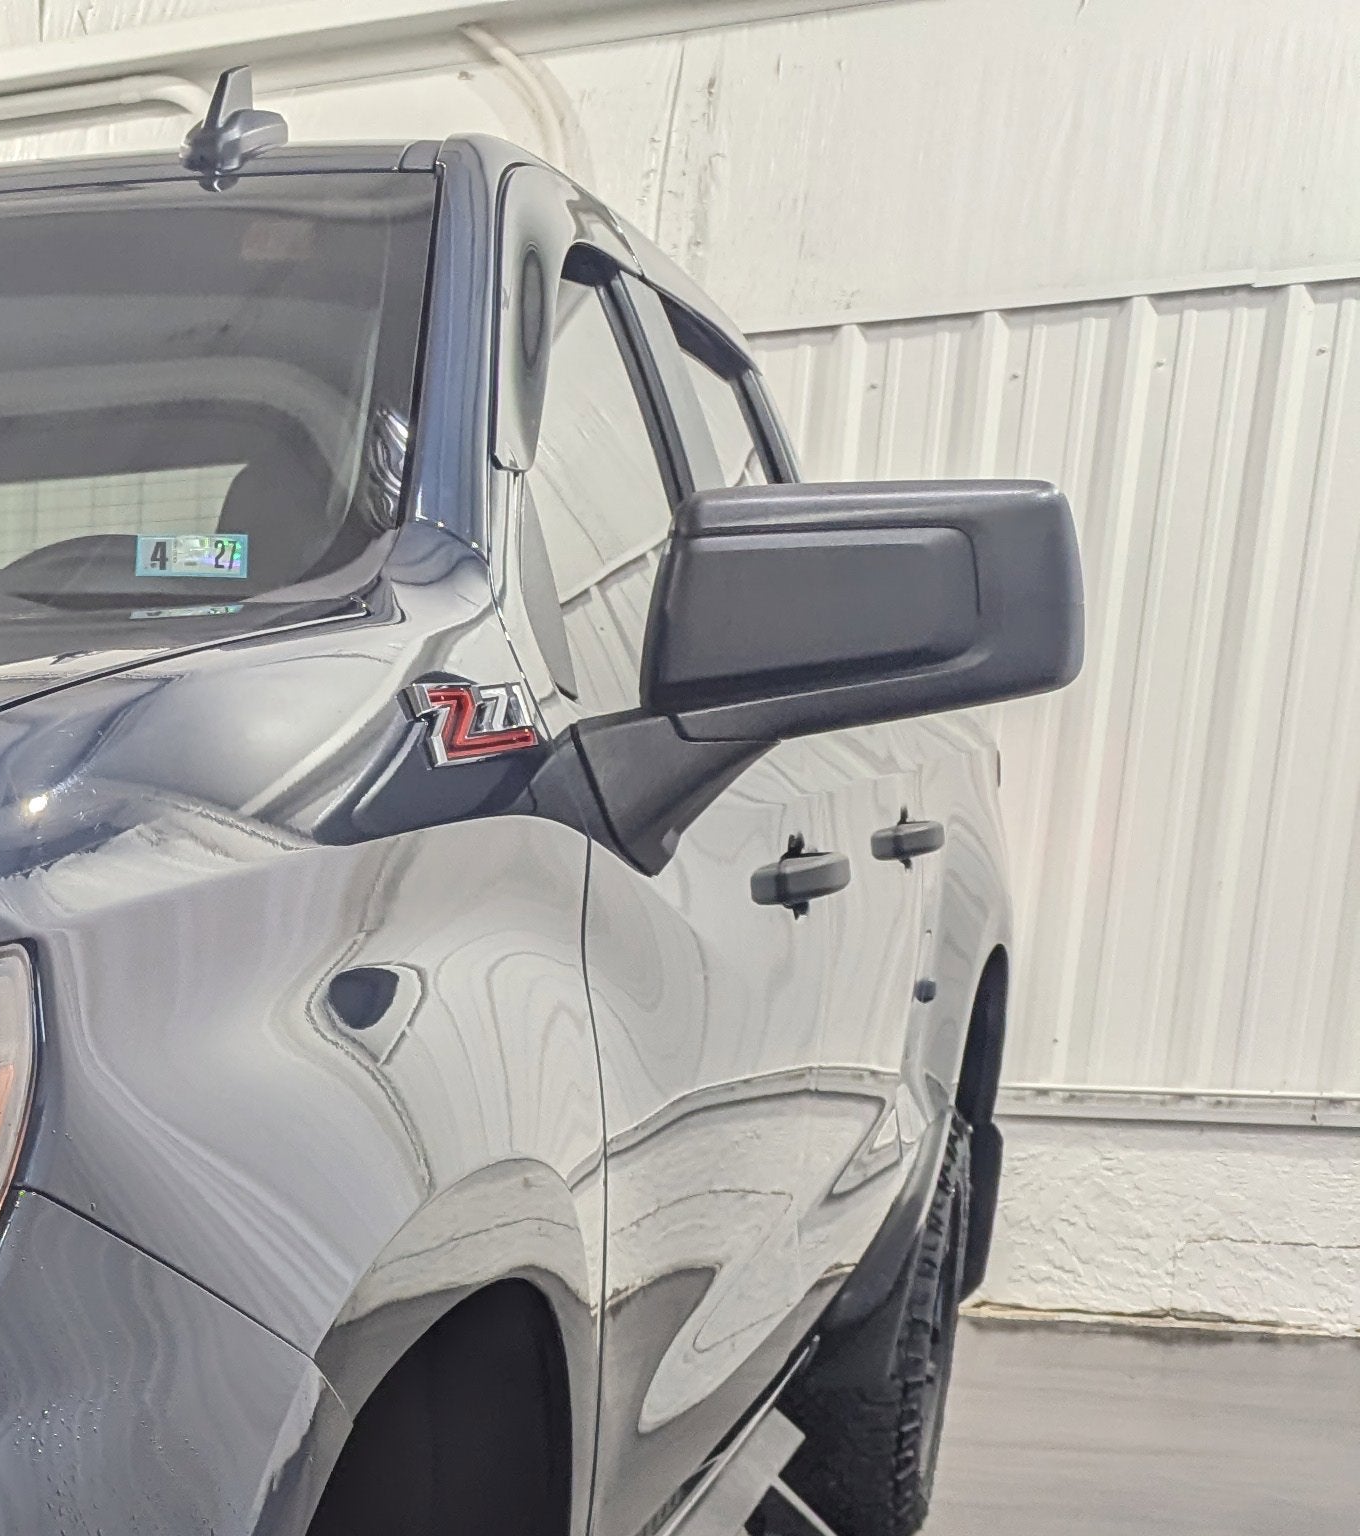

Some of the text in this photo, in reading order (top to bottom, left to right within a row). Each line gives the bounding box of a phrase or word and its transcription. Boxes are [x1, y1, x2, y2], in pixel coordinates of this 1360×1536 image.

[150, 539, 238, 571] 4 27
[412, 681, 539, 768] Z71
